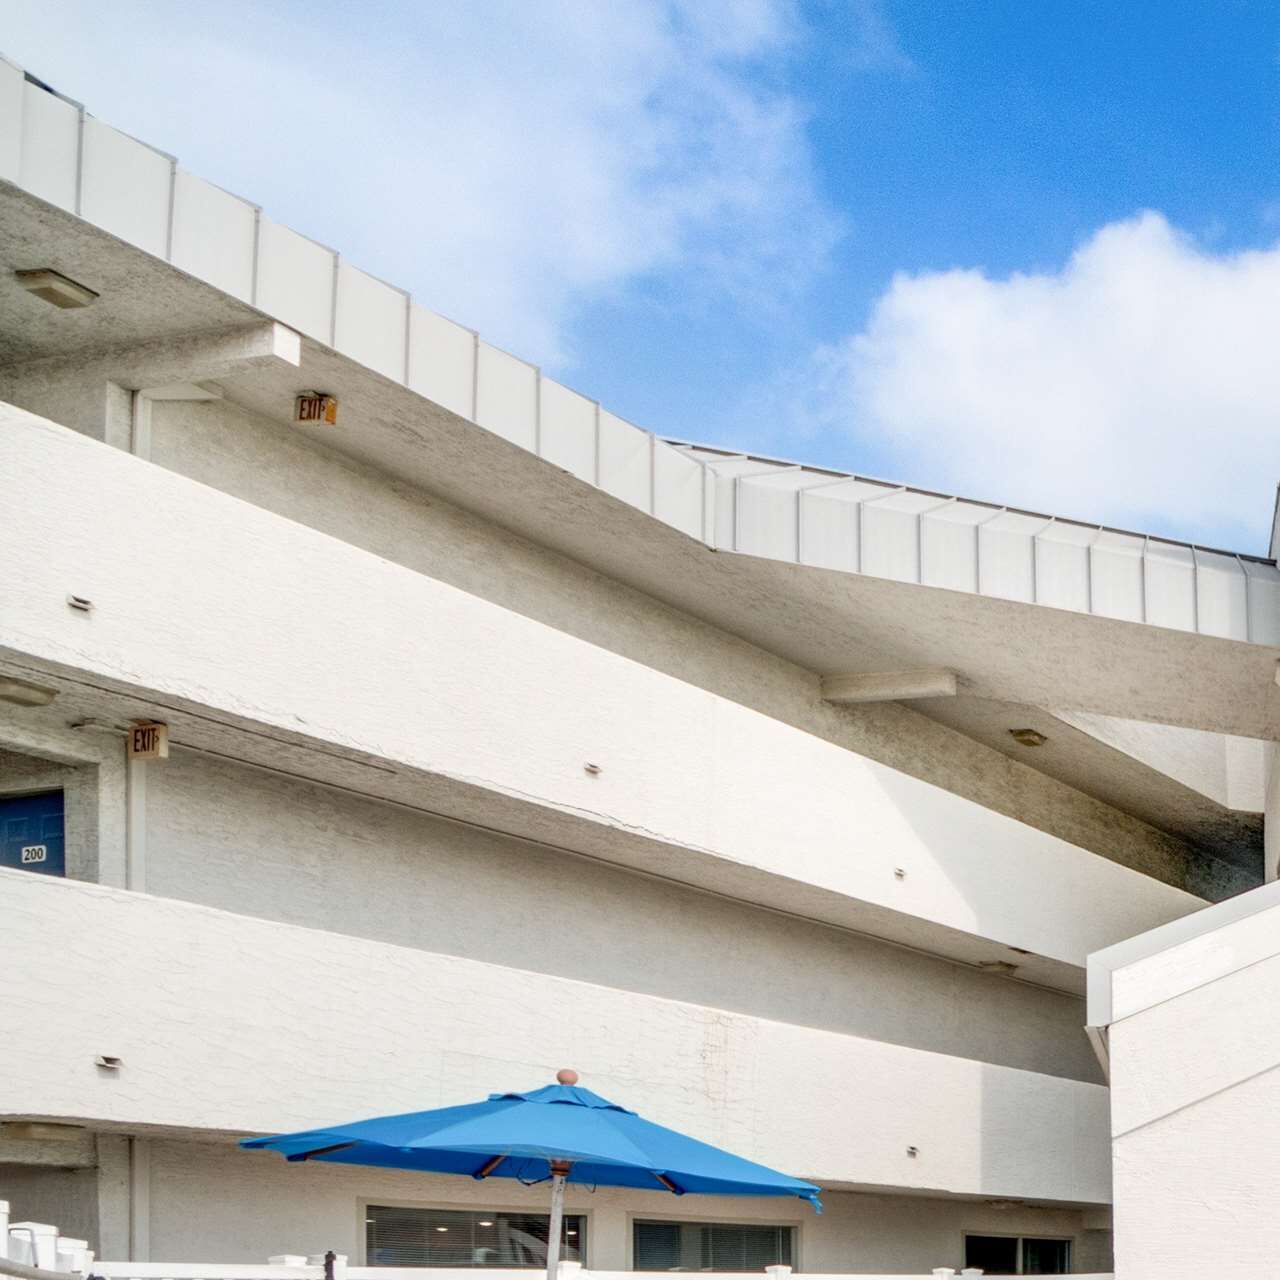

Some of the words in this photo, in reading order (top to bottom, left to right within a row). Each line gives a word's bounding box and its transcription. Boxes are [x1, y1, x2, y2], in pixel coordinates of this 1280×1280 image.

[299, 399, 323, 420] EXIT
[133, 727, 157, 753] EXIT
[24, 847, 44, 861] 200
